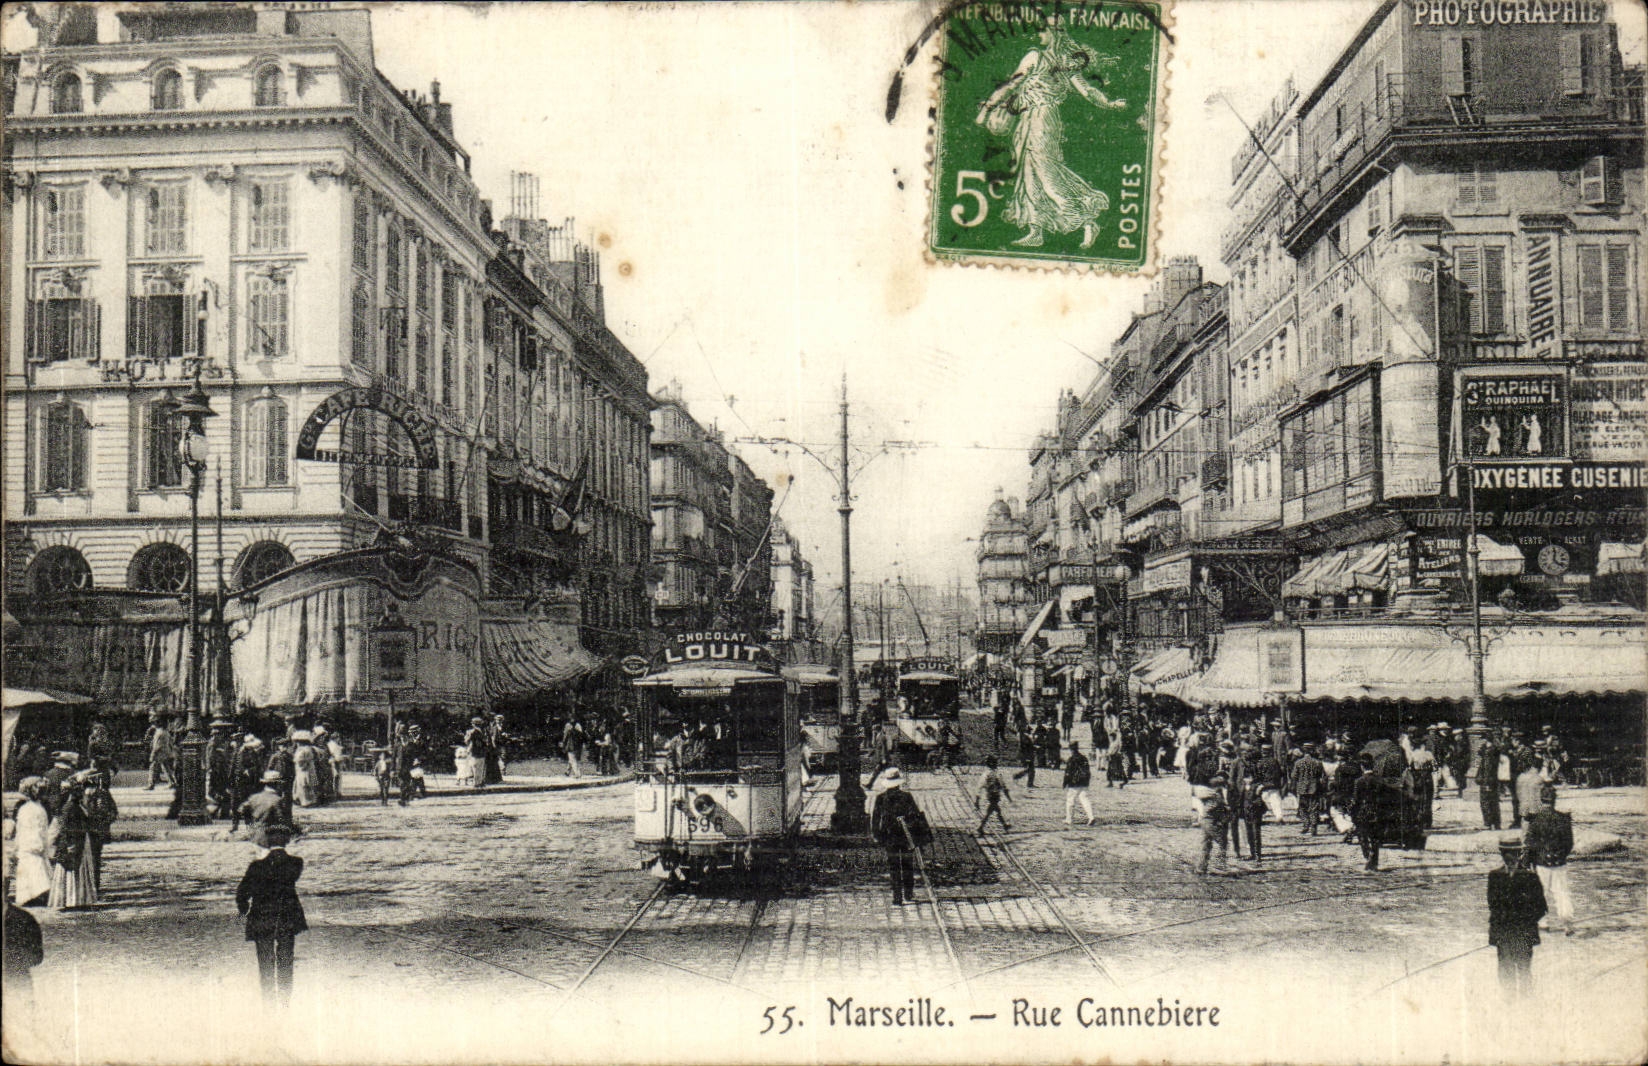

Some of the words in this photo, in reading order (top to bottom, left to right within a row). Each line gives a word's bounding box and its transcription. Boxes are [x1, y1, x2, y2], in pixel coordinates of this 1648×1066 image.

[1413, 0, 1601, 25] PHOTOGRAPHIE
[1117, 163, 1142, 250] POSTES
[1485, 381, 1560, 403] RAPHAEL
[1485, 395, 1544, 405] QUINQUINA
[1417, 512, 1494, 527] OUVRIERS
[1502, 511, 1596, 526] HORLOGERS
[677, 631, 747, 643] CHOCOLAT
[664, 643, 761, 663] LOUIT
